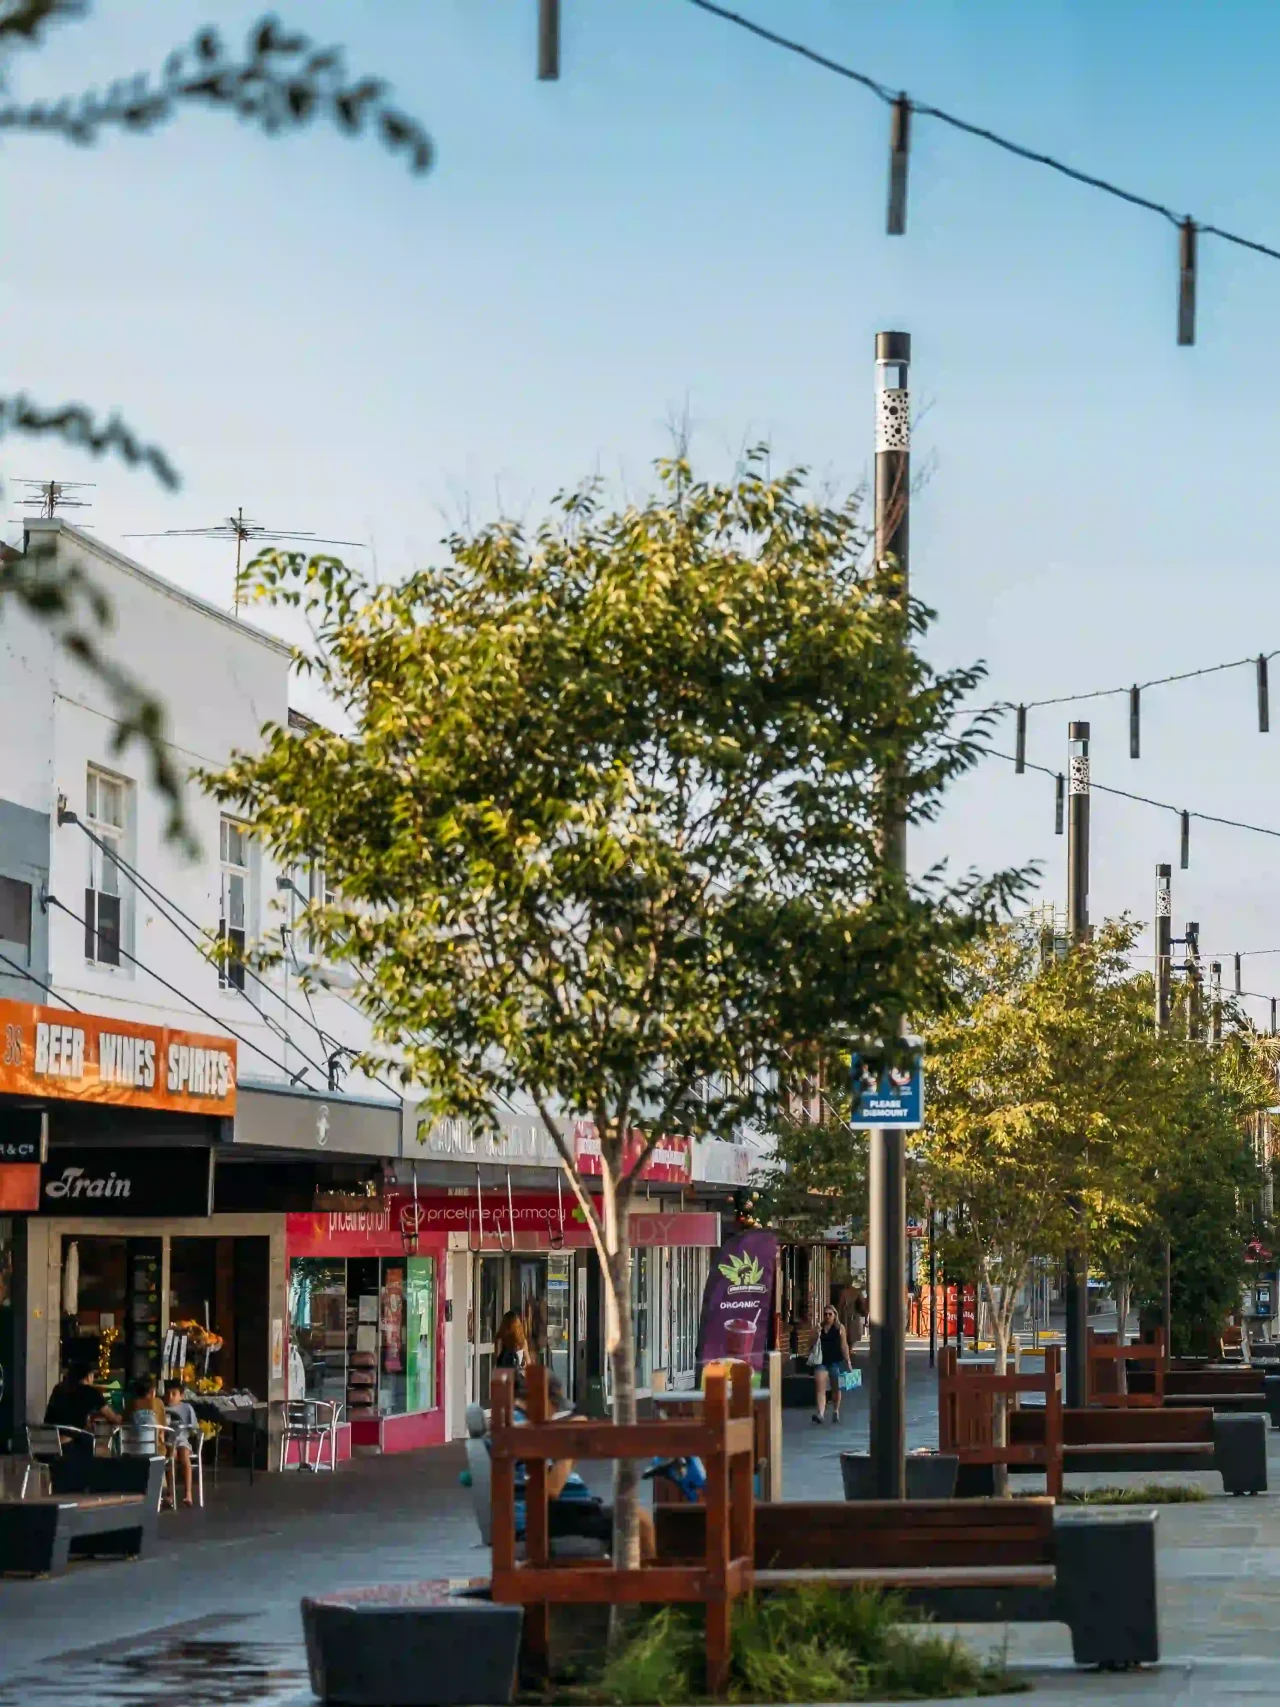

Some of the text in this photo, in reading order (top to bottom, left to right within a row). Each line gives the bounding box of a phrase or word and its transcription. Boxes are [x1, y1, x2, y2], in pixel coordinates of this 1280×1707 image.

[35, 1022, 85, 1078] BEER
[99, 1032, 156, 1087] WINES
[168, 1043, 230, 1096] SPIRITS
[870, 1100, 901, 1108] PLEASE
[863, 1108, 908, 1117] DISMOUNT
[45, 1167, 131, 1198] Train
[427, 1205, 567, 1222] priceline pharmacy
[720, 1300, 760, 1309] ORGANIC
